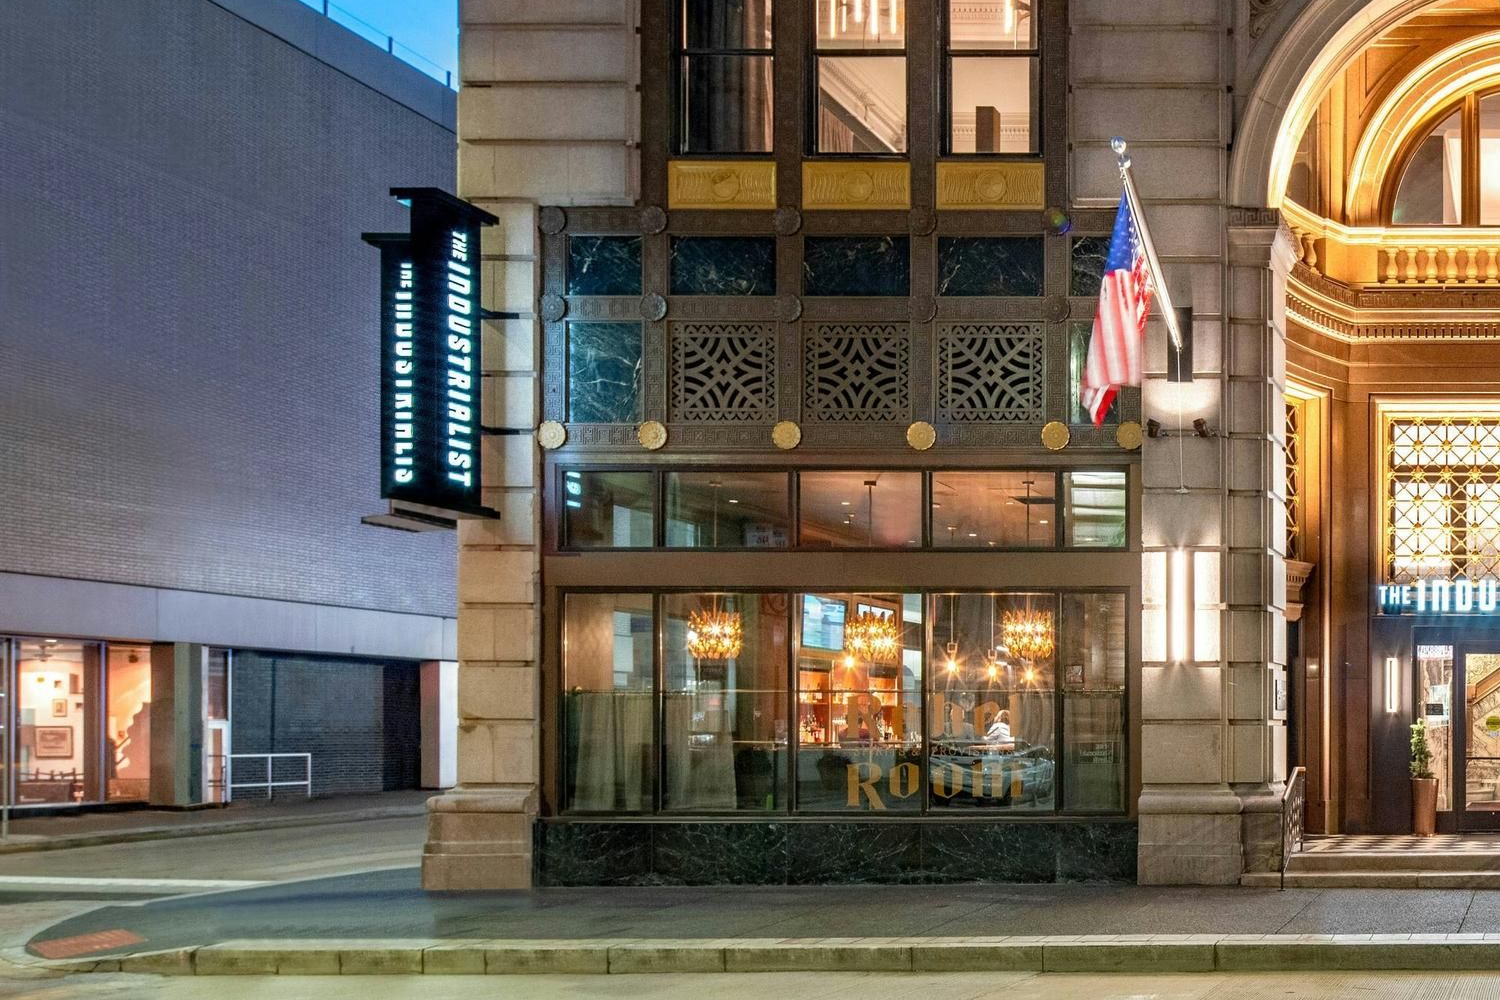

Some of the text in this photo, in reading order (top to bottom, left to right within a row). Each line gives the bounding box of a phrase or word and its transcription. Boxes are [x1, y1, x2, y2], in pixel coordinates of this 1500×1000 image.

[447, 230, 472, 488] THE INDUSTRIALIST
[1378, 585, 1411, 605] THE
[847, 762, 1024, 810] Room
